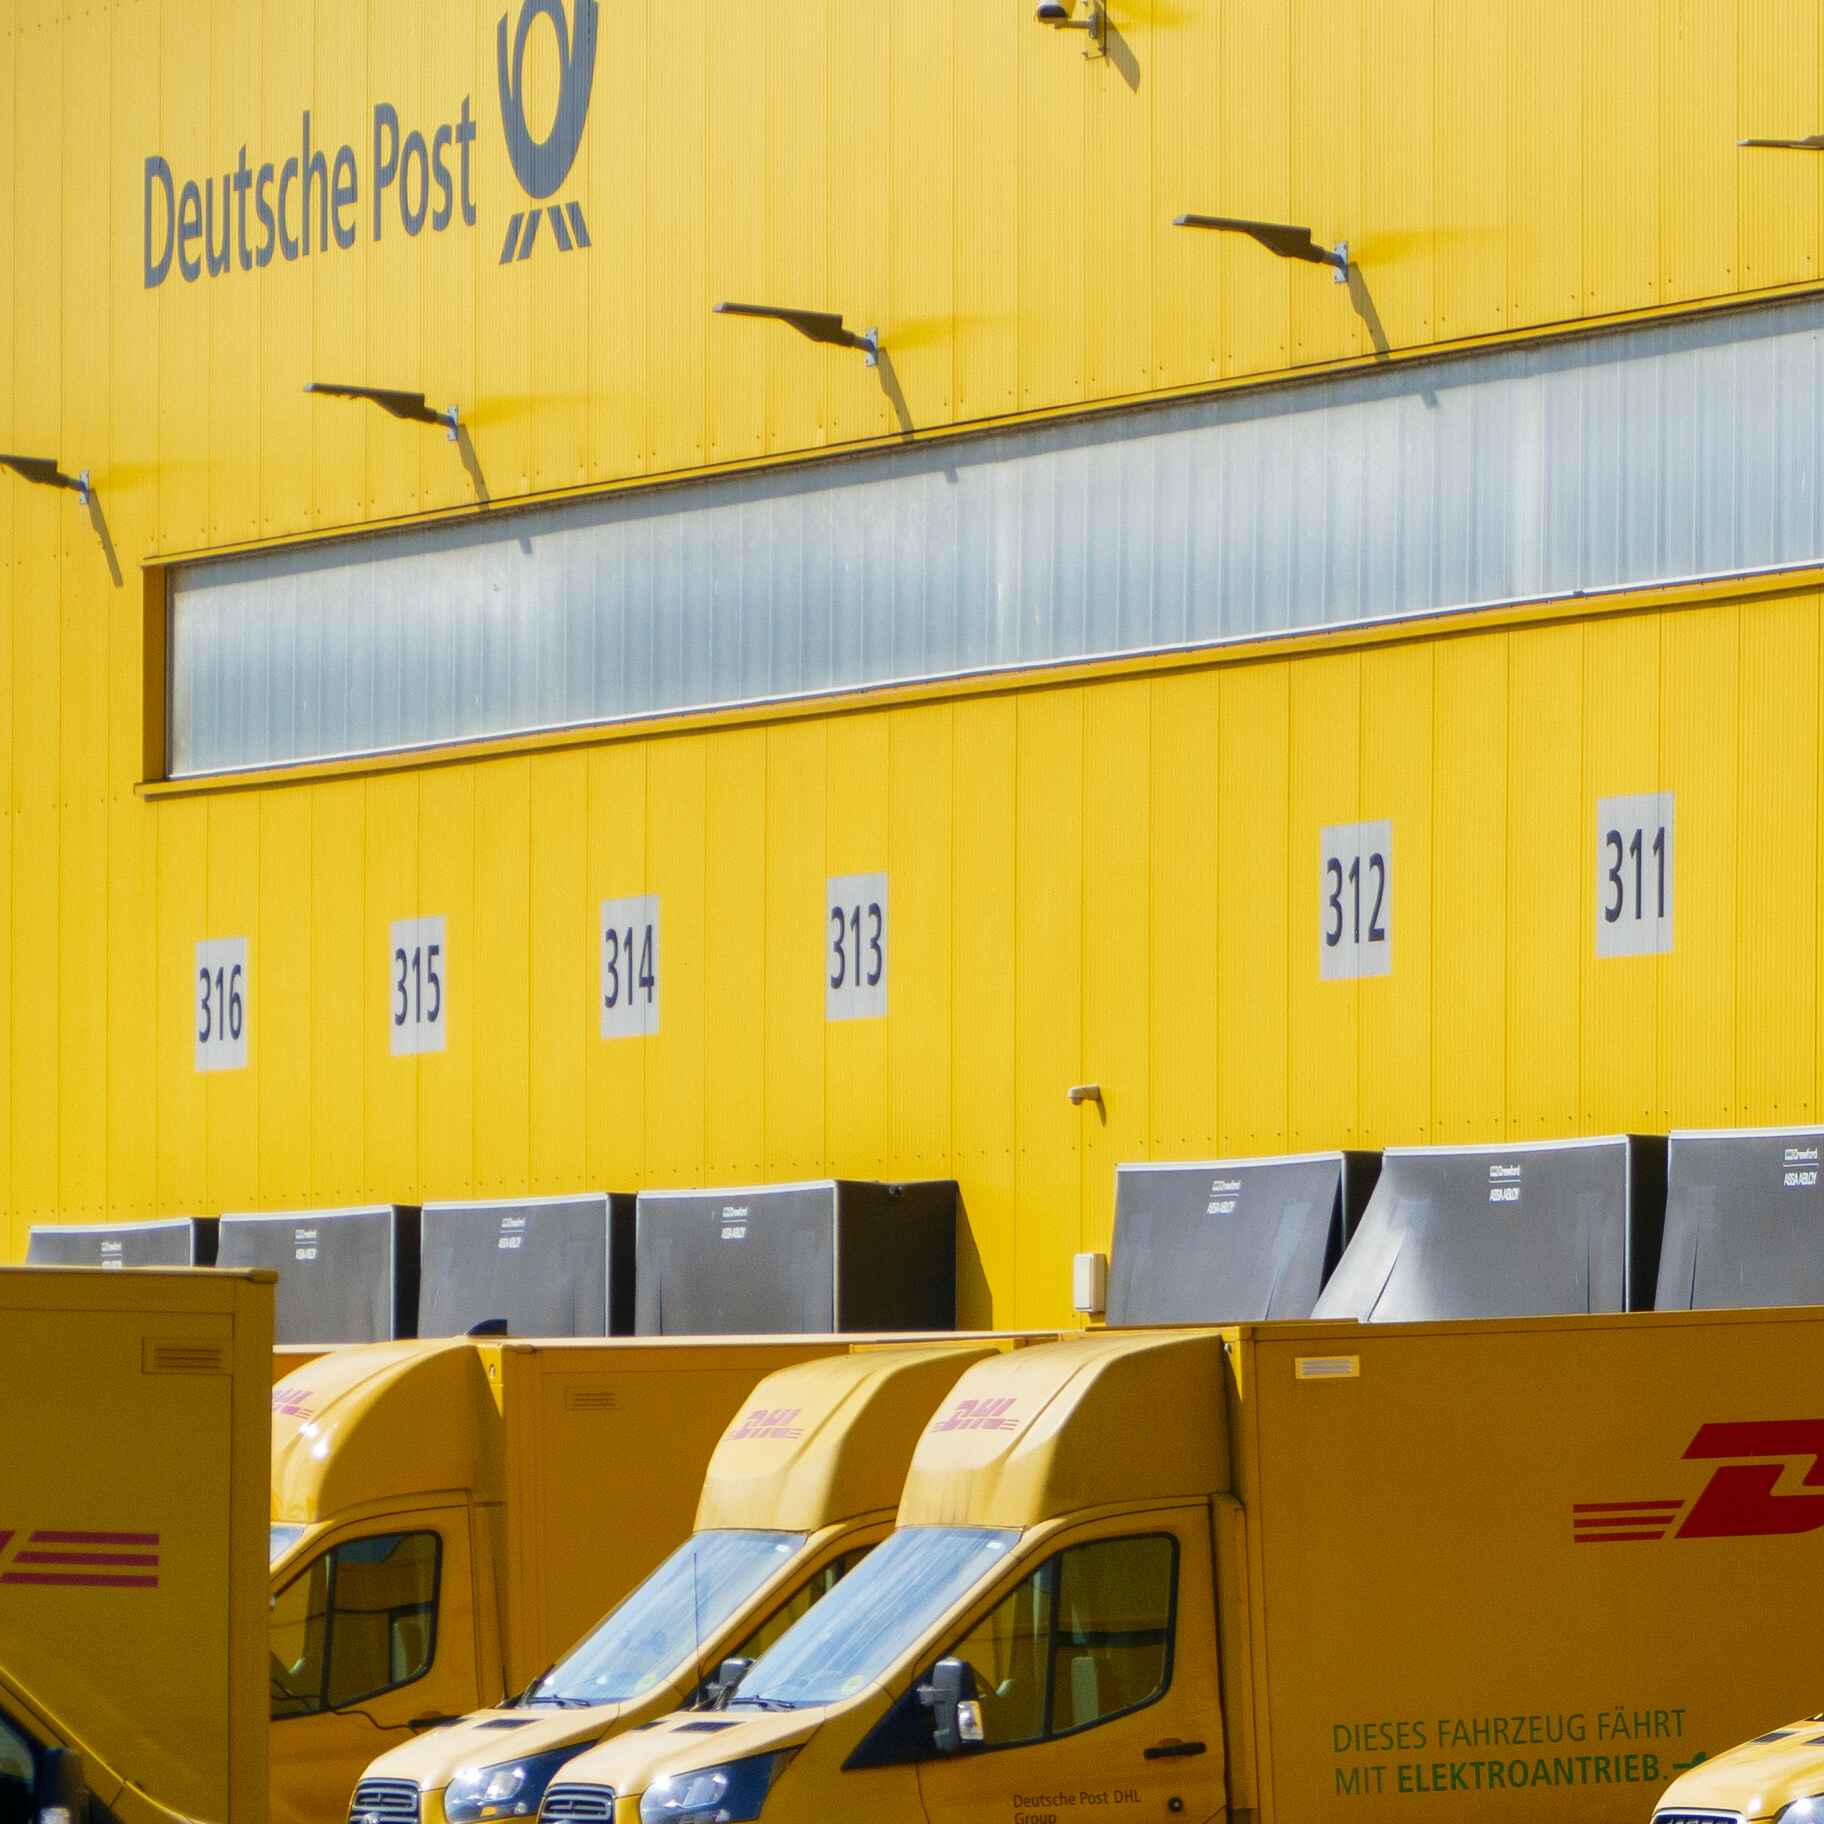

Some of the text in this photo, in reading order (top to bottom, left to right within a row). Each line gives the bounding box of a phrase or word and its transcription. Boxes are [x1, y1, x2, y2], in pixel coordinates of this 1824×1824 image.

[143, 95, 478, 290] Deutsche Post
[1326, 852, 1385, 947] 312
[1605, 826, 1665, 923] 311
[395, 944, 441, 1026] 315
[605, 924, 655, 1009] 314
[830, 902, 883, 990] 313
[199, 964, 242, 1044] 316
[1332, 1706, 1687, 1753] DIESES FAHRZEUG FÄHRT
[1013, 1790, 1142, 1808] Deutsche Post DHL
[1335, 1753, 1669, 1796] MIT ELEKTROANTRIEB.
